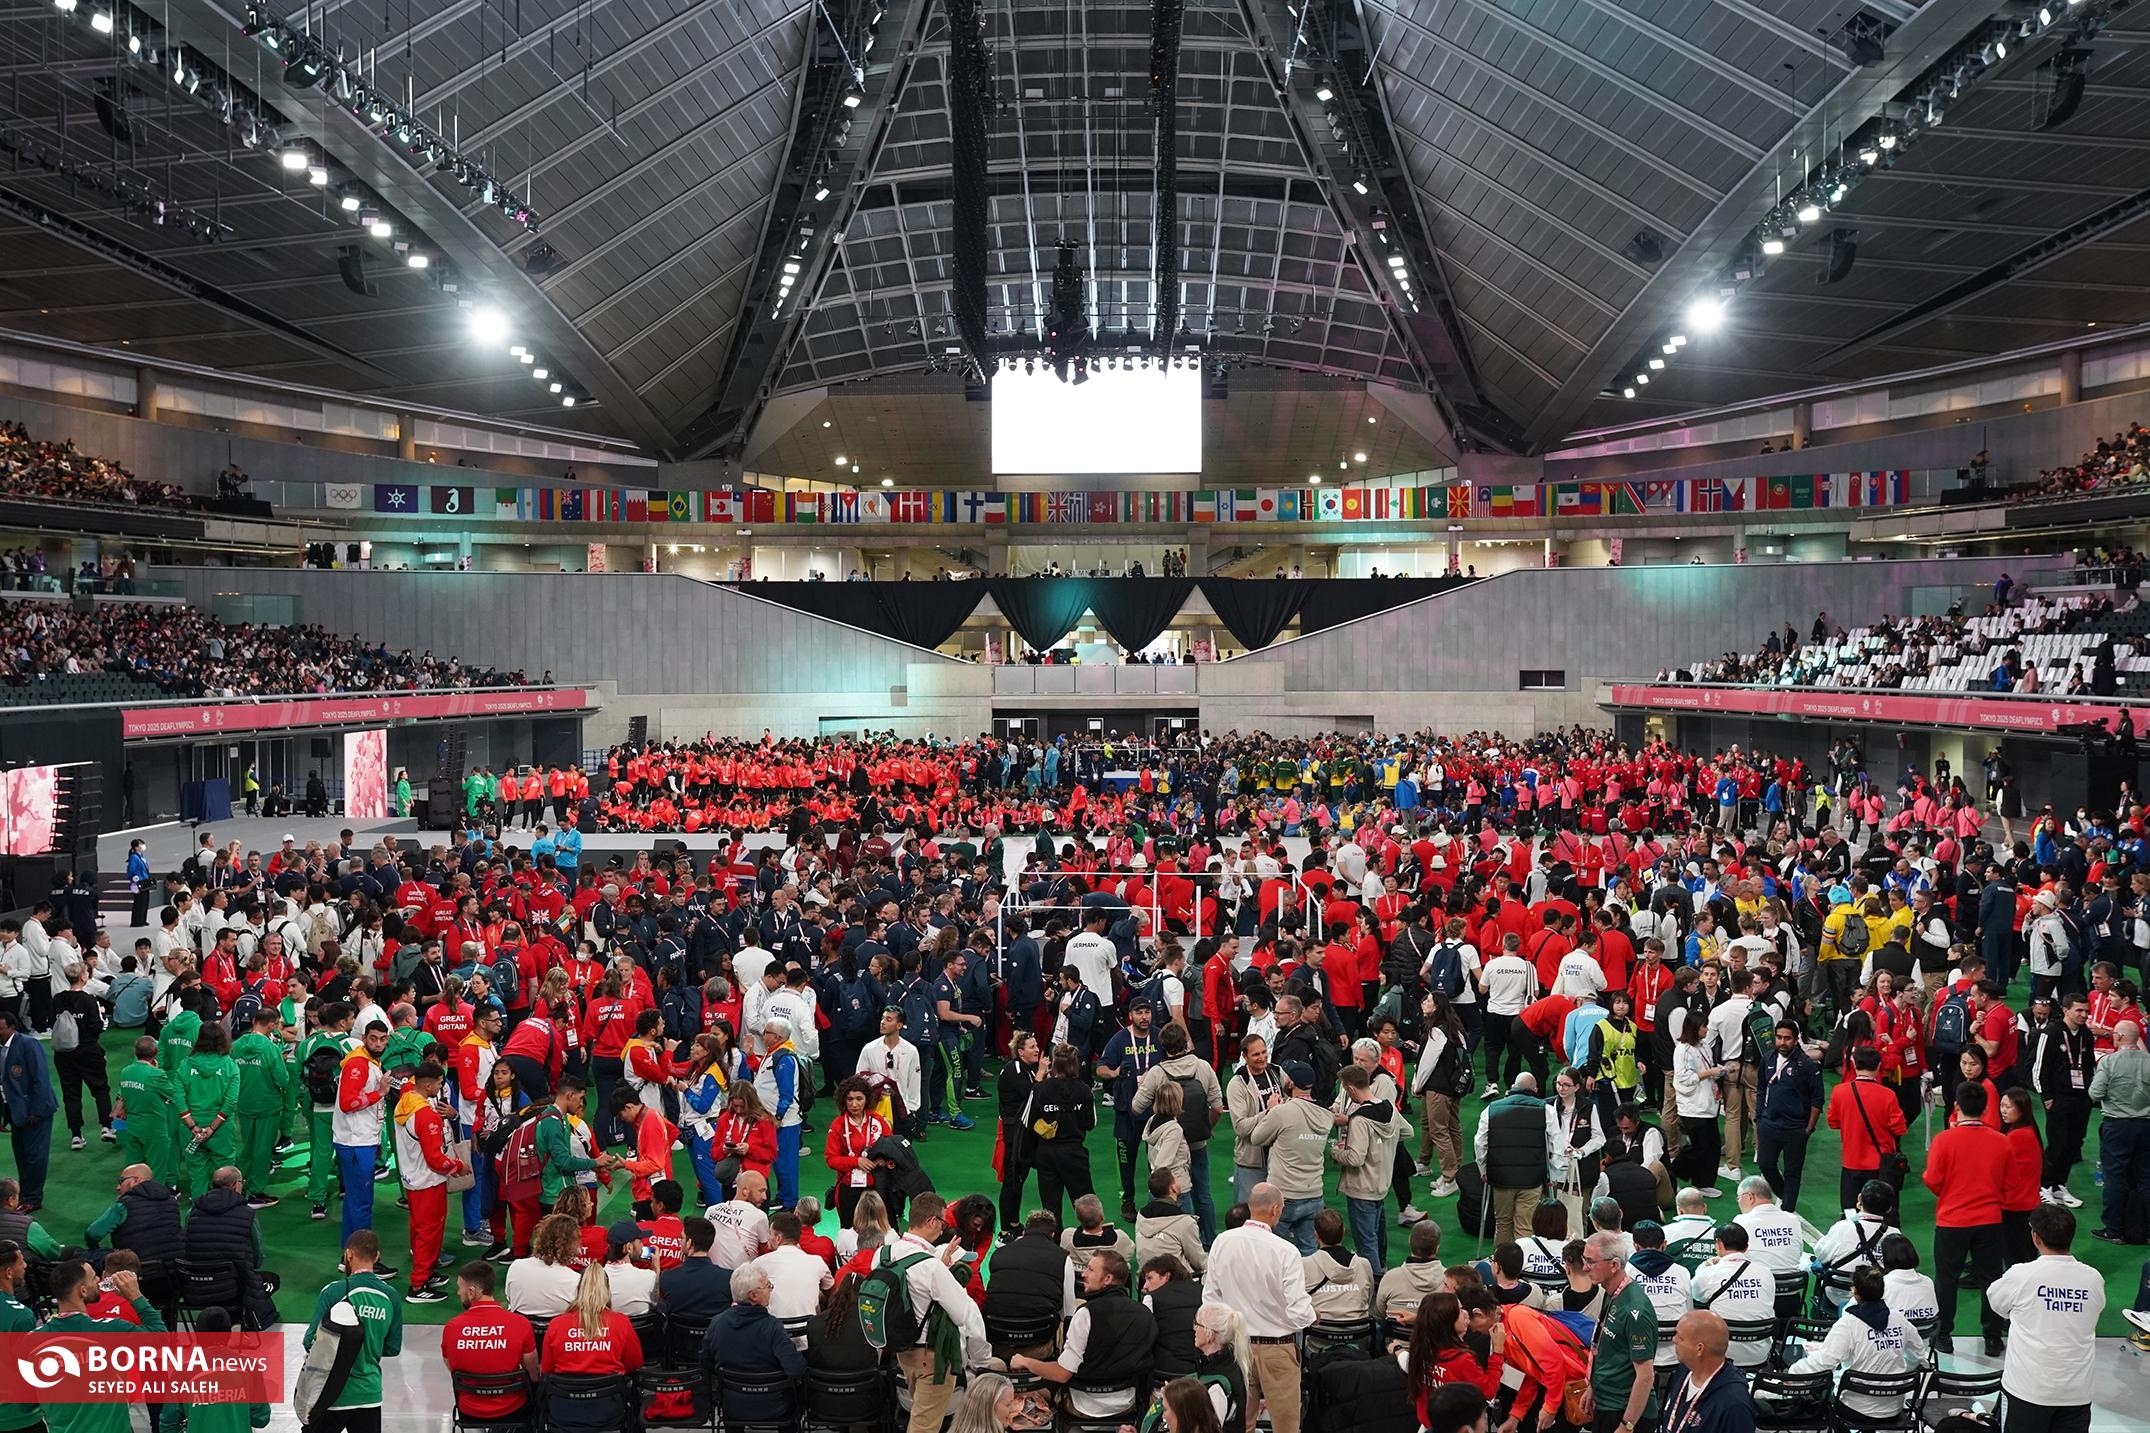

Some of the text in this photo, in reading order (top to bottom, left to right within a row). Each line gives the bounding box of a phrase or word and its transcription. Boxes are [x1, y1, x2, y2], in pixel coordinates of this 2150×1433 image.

[1980, 713, 1996, 723] TOKYO
[1997, 714, 2009, 723] 2025
[128, 724, 146, 732] TOKYO
[147, 723, 159, 731] 2025
[440, 1015, 465, 1023] GREAT
[437, 1022, 467, 1031] BRITAIN
[952, 1046, 962, 1079] BRASIL
[1755, 1227, 1793, 1238] CHINESE
[1761, 1237, 1791, 1248] TAIPEI
[1727, 1288, 1759, 1300] TAIPEI
[2037, 1285, 2089, 1300] CHINESE
[2044, 1298, 2083, 1313] TAIPEI
[461, 1326, 505, 1336] GREAT
[457, 1338, 507, 1350] BRITAIN
[564, 1341, 612, 1352] BRITAIN
[1874, 1338, 1903, 1352] TAIPEI
